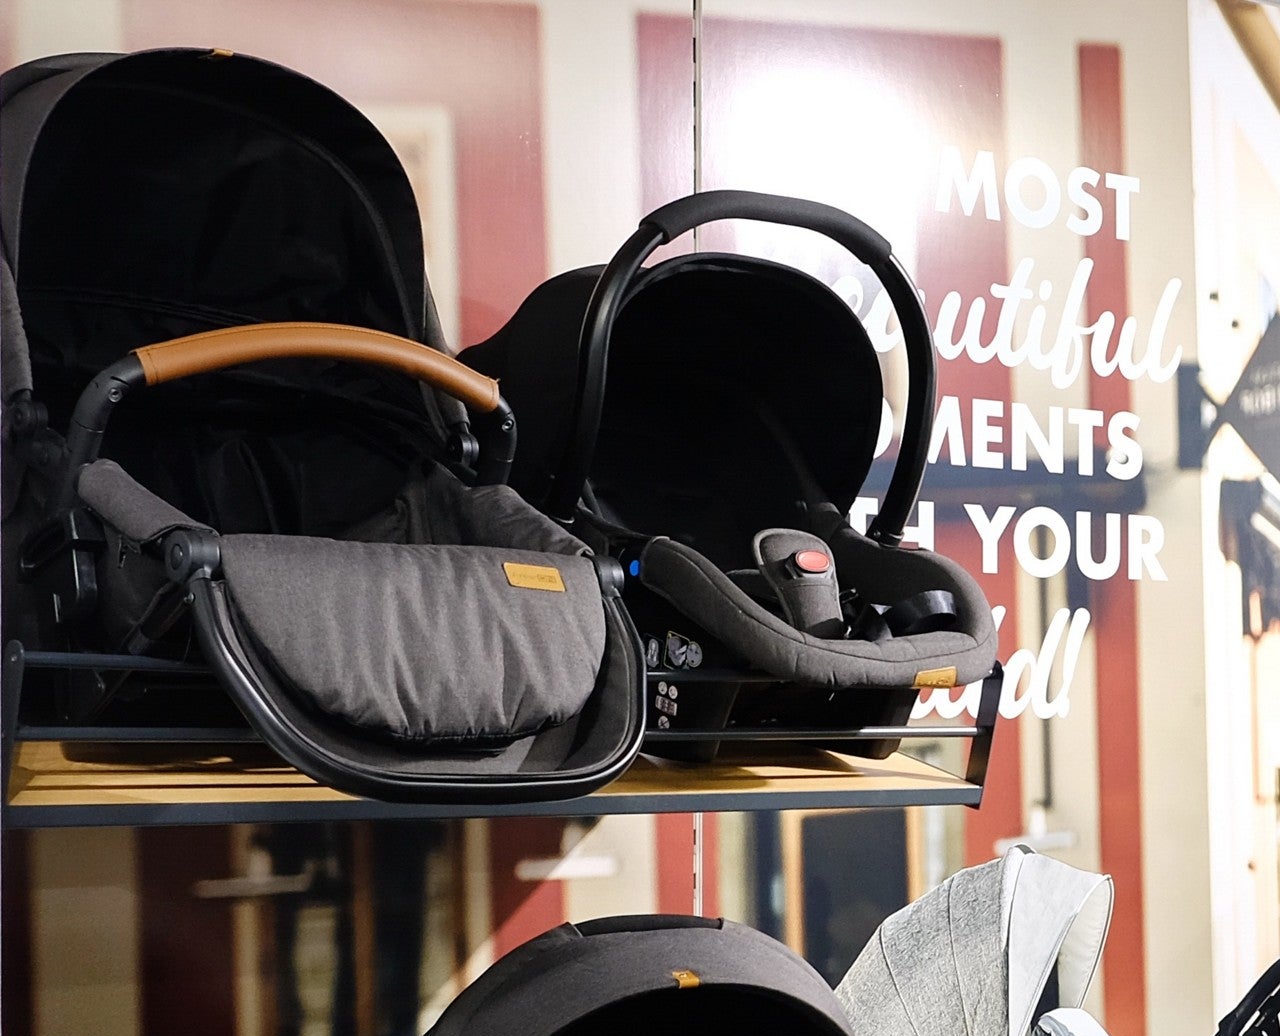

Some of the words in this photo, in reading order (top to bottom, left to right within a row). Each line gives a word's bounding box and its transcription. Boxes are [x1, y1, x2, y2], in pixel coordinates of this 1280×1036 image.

[934, 144, 1141, 241] MOST
[873, 395, 1144, 481] MENTS
[963, 503, 1169, 582] YOUR
